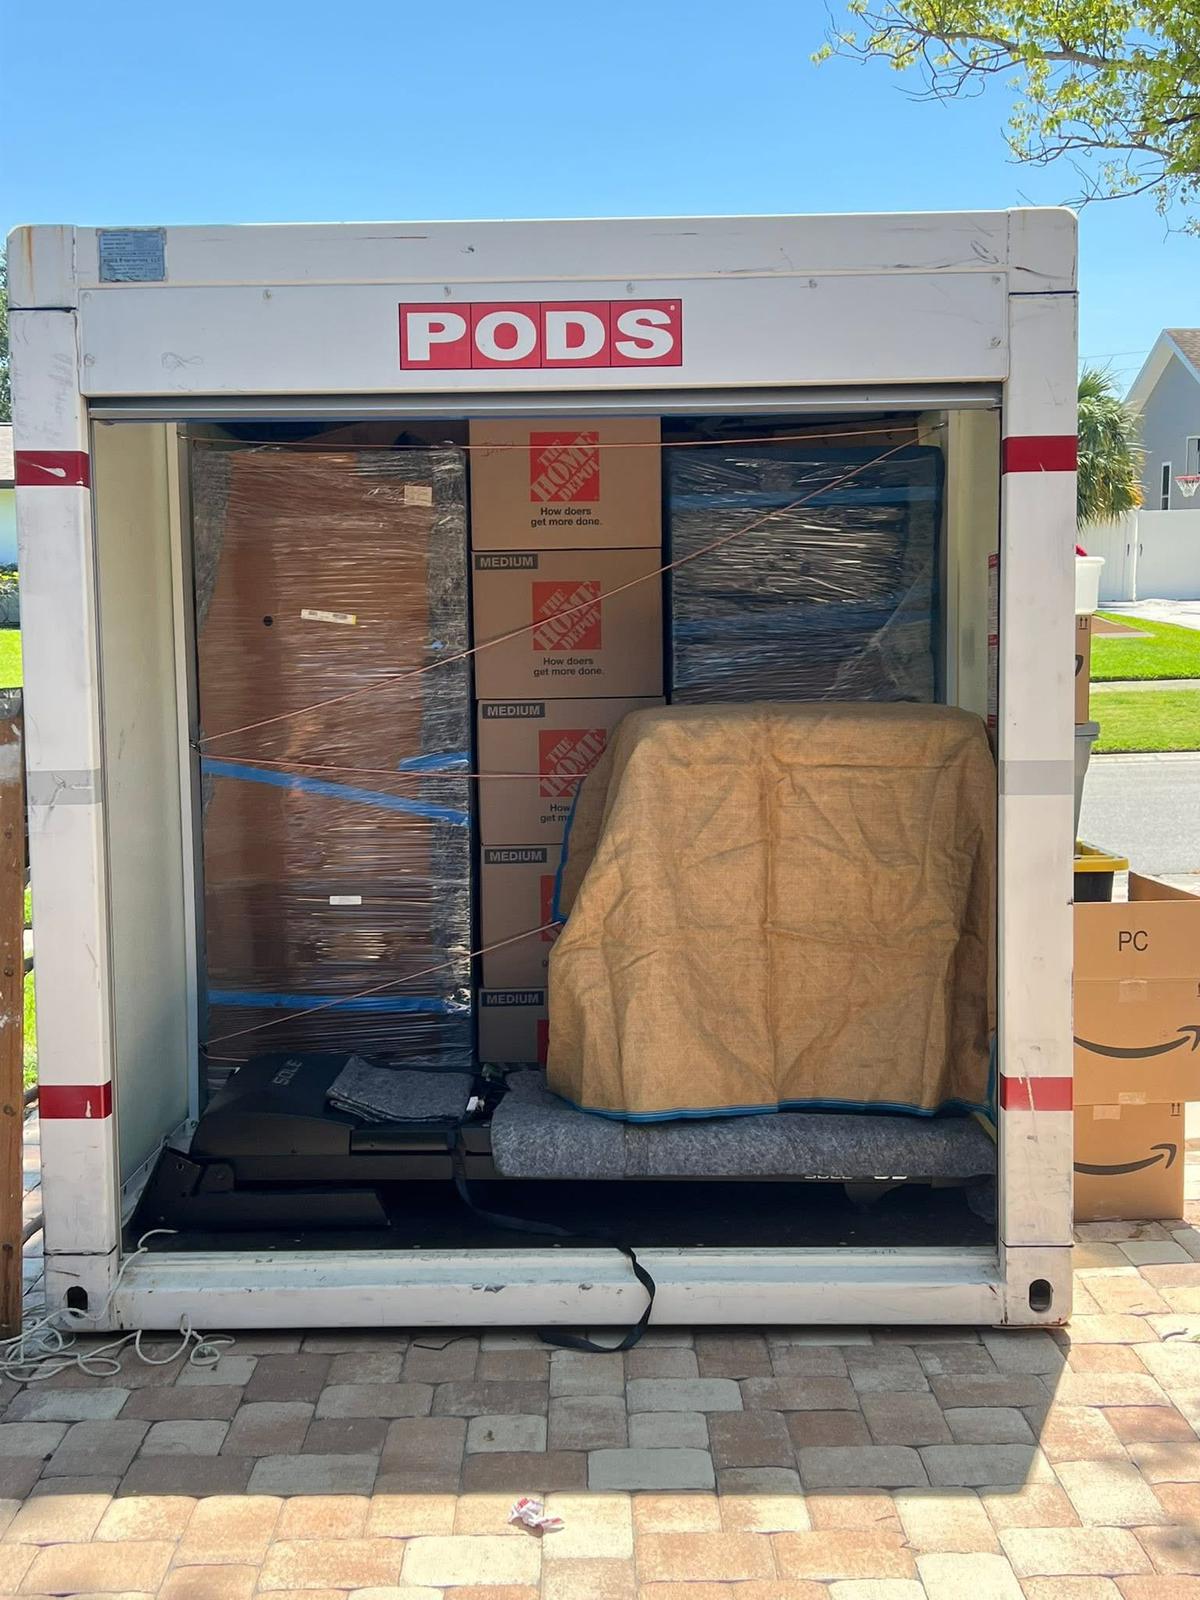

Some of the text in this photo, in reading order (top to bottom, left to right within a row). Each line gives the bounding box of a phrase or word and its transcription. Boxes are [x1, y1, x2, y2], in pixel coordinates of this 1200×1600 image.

[406, 307, 675, 362] PODS
[531, 431, 599, 501] HOME
[540, 507, 592, 516] How doers
[530, 518, 547, 528] get
[549, 518, 574, 526] more
[480, 556, 534, 568] MEDIUM
[538, 588, 567, 616] THE
[533, 580, 601, 650] HOME
[543, 656, 594, 666] How doers
[533, 667, 549, 677] get
[551, 668, 576, 676] more
[487, 705, 541, 717] MEDIUM
[545, 736, 574, 764] THE
[549, 803, 570, 812] How
[540, 813, 556, 824] get
[489, 850, 543, 862] MEDIUM
[1118, 930, 1149, 952] PC
[486, 992, 540, 1005] MEDIUM
